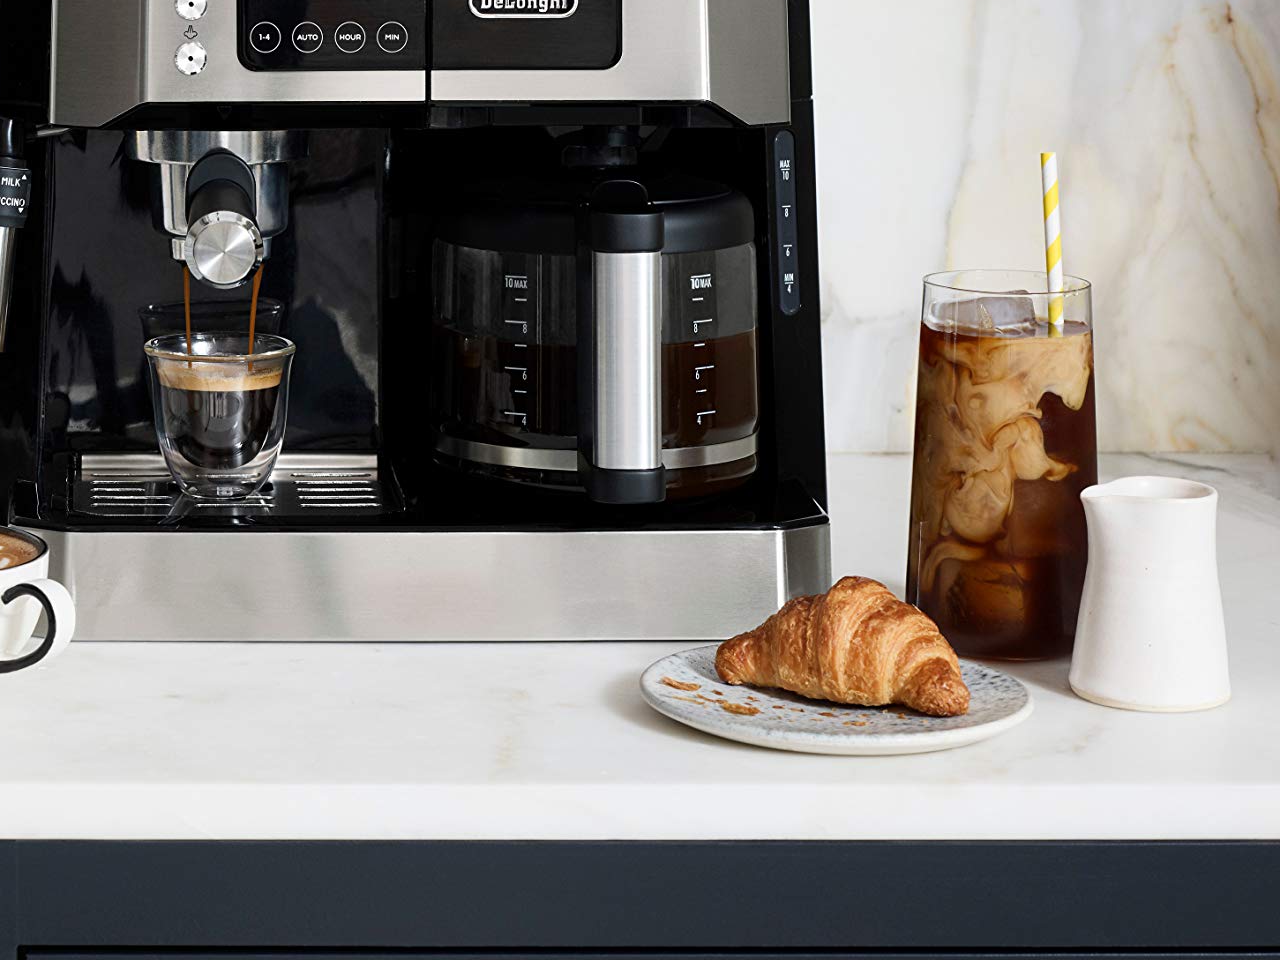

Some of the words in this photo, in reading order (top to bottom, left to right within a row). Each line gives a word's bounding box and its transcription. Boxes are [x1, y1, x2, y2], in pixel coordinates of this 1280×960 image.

[258, 33, 270, 41] 1-4
[296, 33, 319, 41] AUTO
[339, 33, 362, 41] HOUR
[384, 33, 400, 41] MIN
[779, 159, 791, 168] MAX
[782, 170, 790, 181] 10
[1, 176, 21, 187] MILK
[784, 273, 794, 282] MIN
